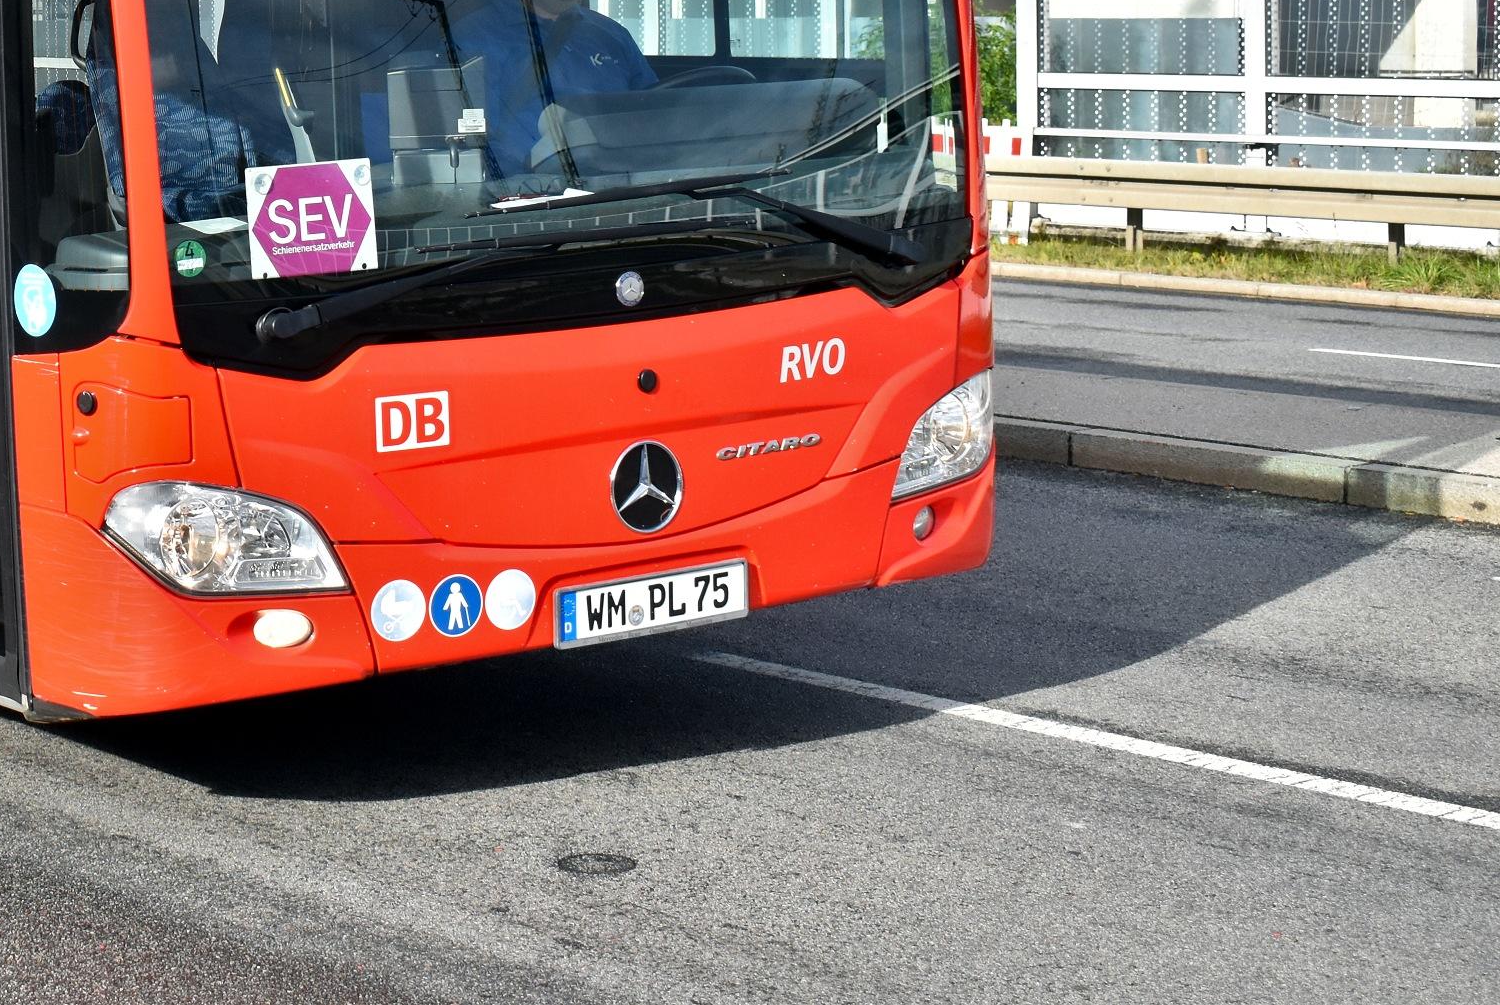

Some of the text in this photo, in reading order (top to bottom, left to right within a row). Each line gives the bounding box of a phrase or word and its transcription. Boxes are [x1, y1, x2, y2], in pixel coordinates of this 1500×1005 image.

[268, 194, 352, 244] SEV
[185, 241, 194, 258] 4
[272, 240, 356, 256] Schienenersatzverkehr
[780, 338, 845, 383] RVO
[381, 397, 445, 447] DB
[716, 433, 821, 461] CITARO
[564, 621, 573, 634] D
[586, 590, 626, 631] WM
[648, 582, 687, 620] PL
[694, 571, 729, 613] 75
